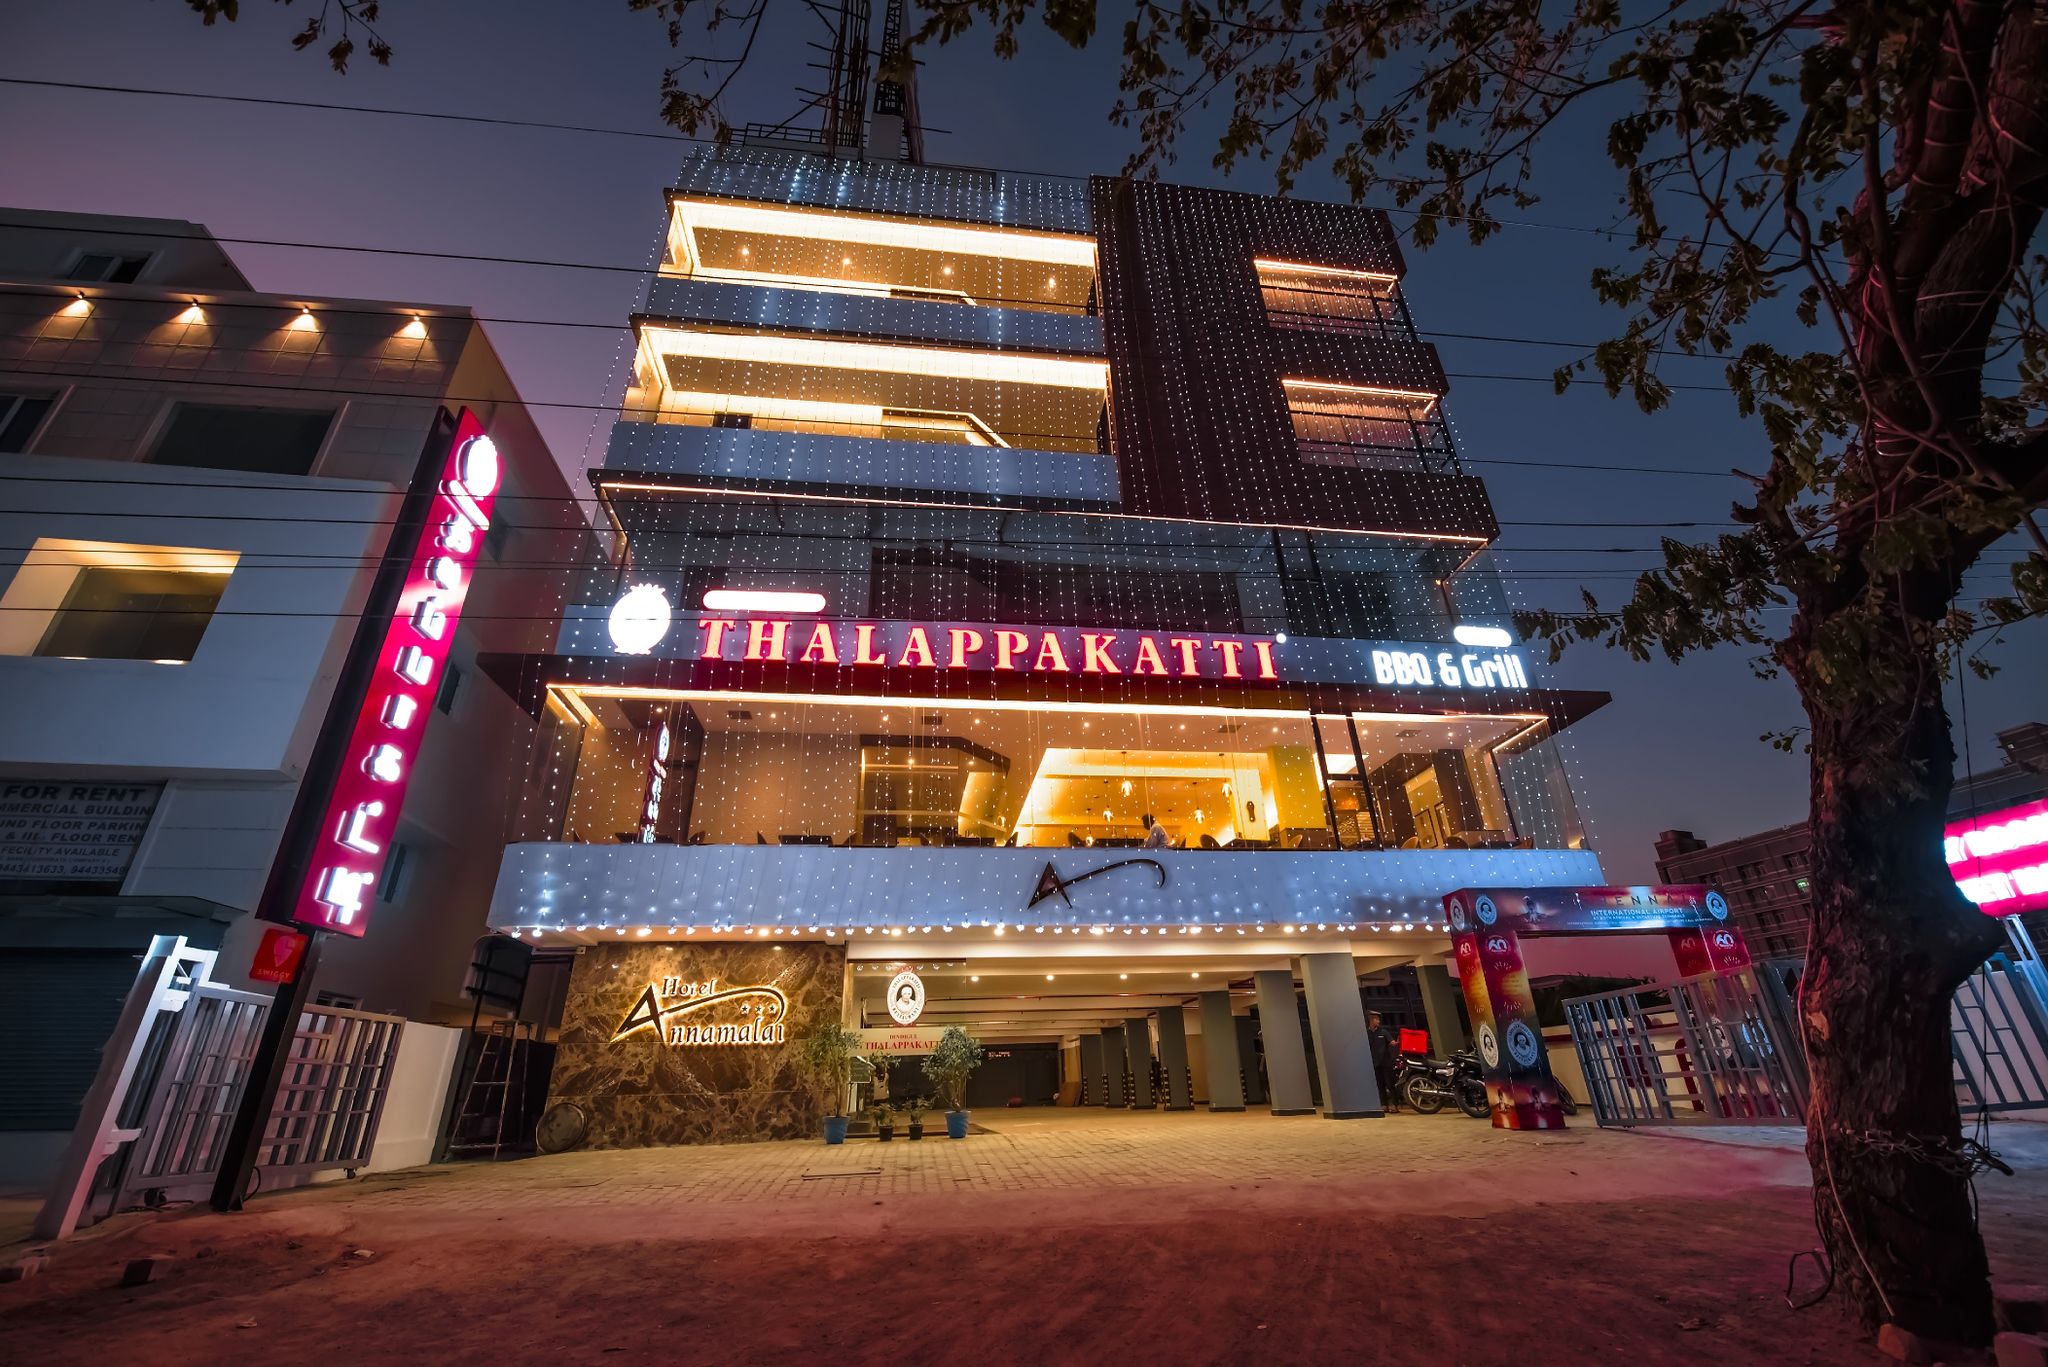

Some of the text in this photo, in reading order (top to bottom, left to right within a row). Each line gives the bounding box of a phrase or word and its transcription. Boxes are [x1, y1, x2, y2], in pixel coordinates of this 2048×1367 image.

[698, 618, 1279, 680] THALAPPAKATTI
[1371, 650, 1529, 688] BBQ & Grill
[2, 785, 147, 802] FOR RENT
[31, 820, 83, 830] FLOOR
[50, 833, 102, 842] FLOOR
[54, 848, 121, 857] AVAILABLE
[1590, 908, 1651, 917] INTERNATIONAL
[1653, 907, 1683, 915] AIRPORT
[661, 976, 717, 996] Hotel
[609, 983, 786, 1046] Annamalai
